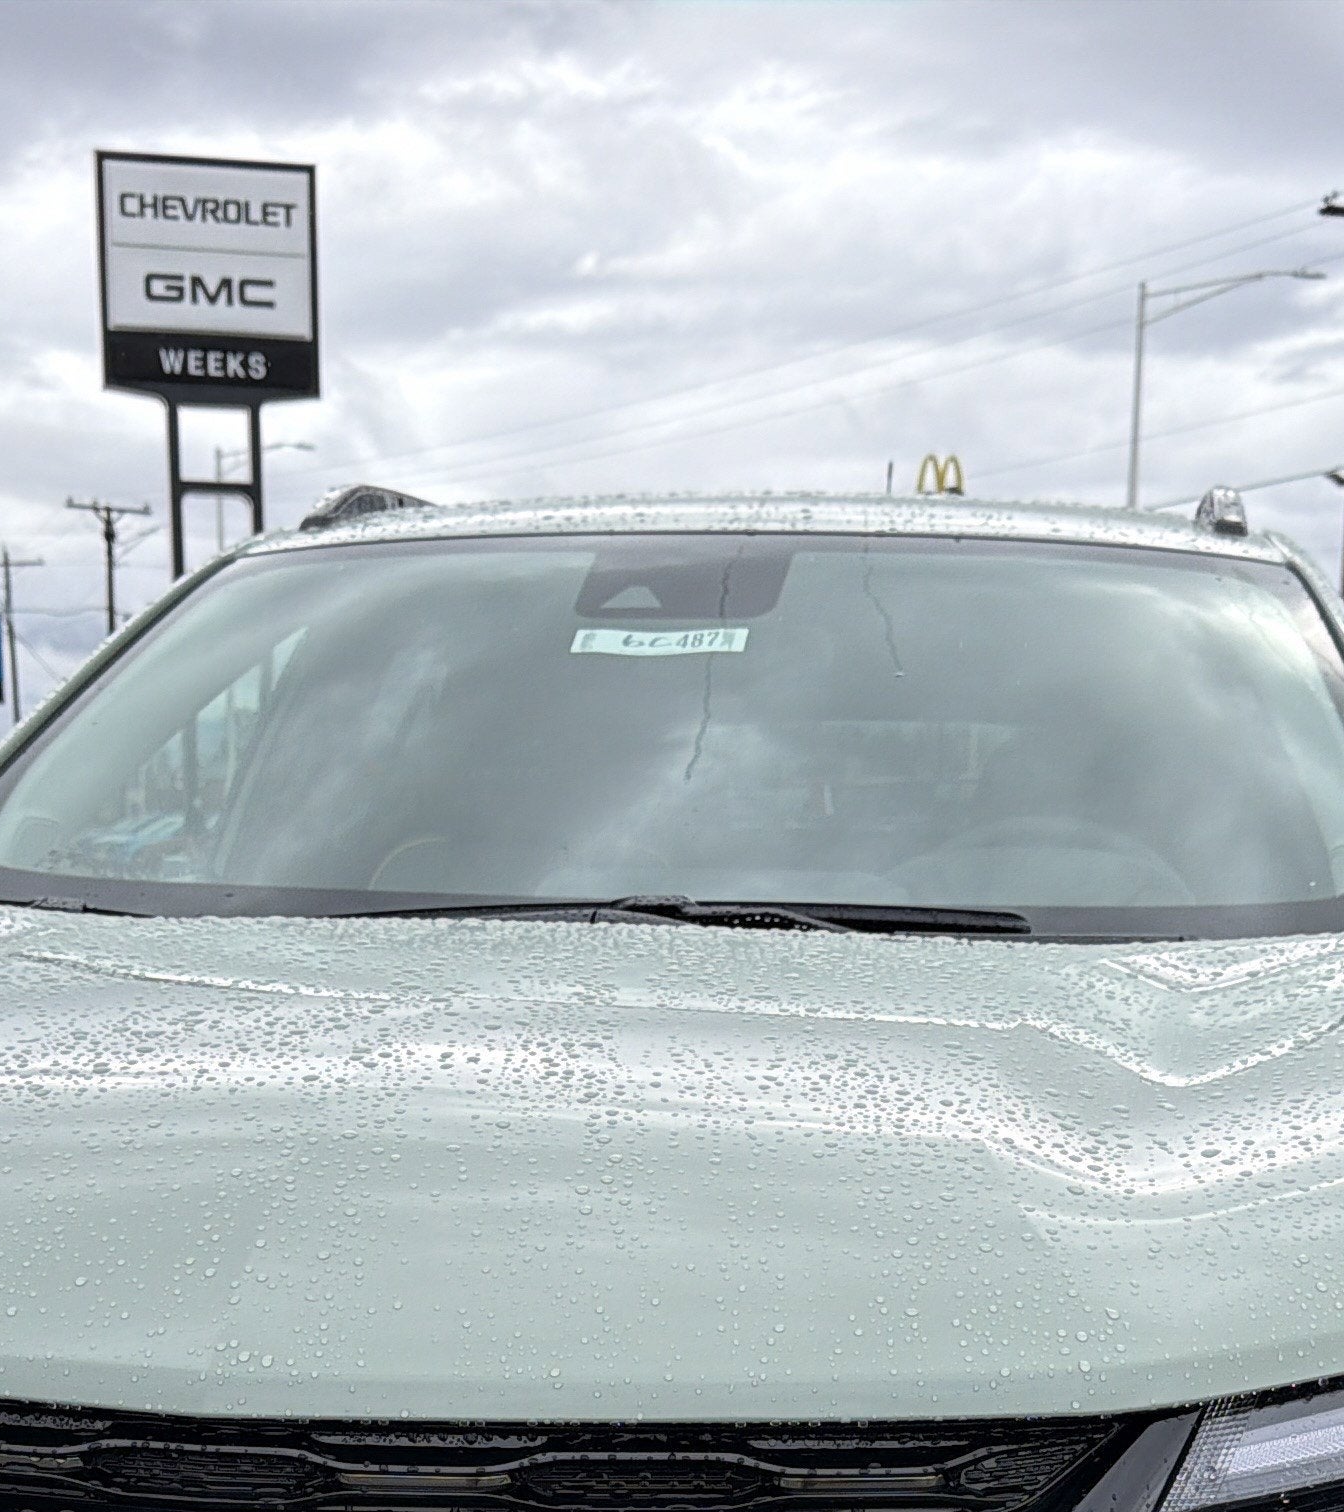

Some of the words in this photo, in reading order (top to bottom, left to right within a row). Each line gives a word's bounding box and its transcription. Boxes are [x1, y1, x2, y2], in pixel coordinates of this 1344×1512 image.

[118, 192, 297, 228] CHEVROLET
[144, 273, 276, 309] GMC
[158, 347, 268, 381] WEEKS
